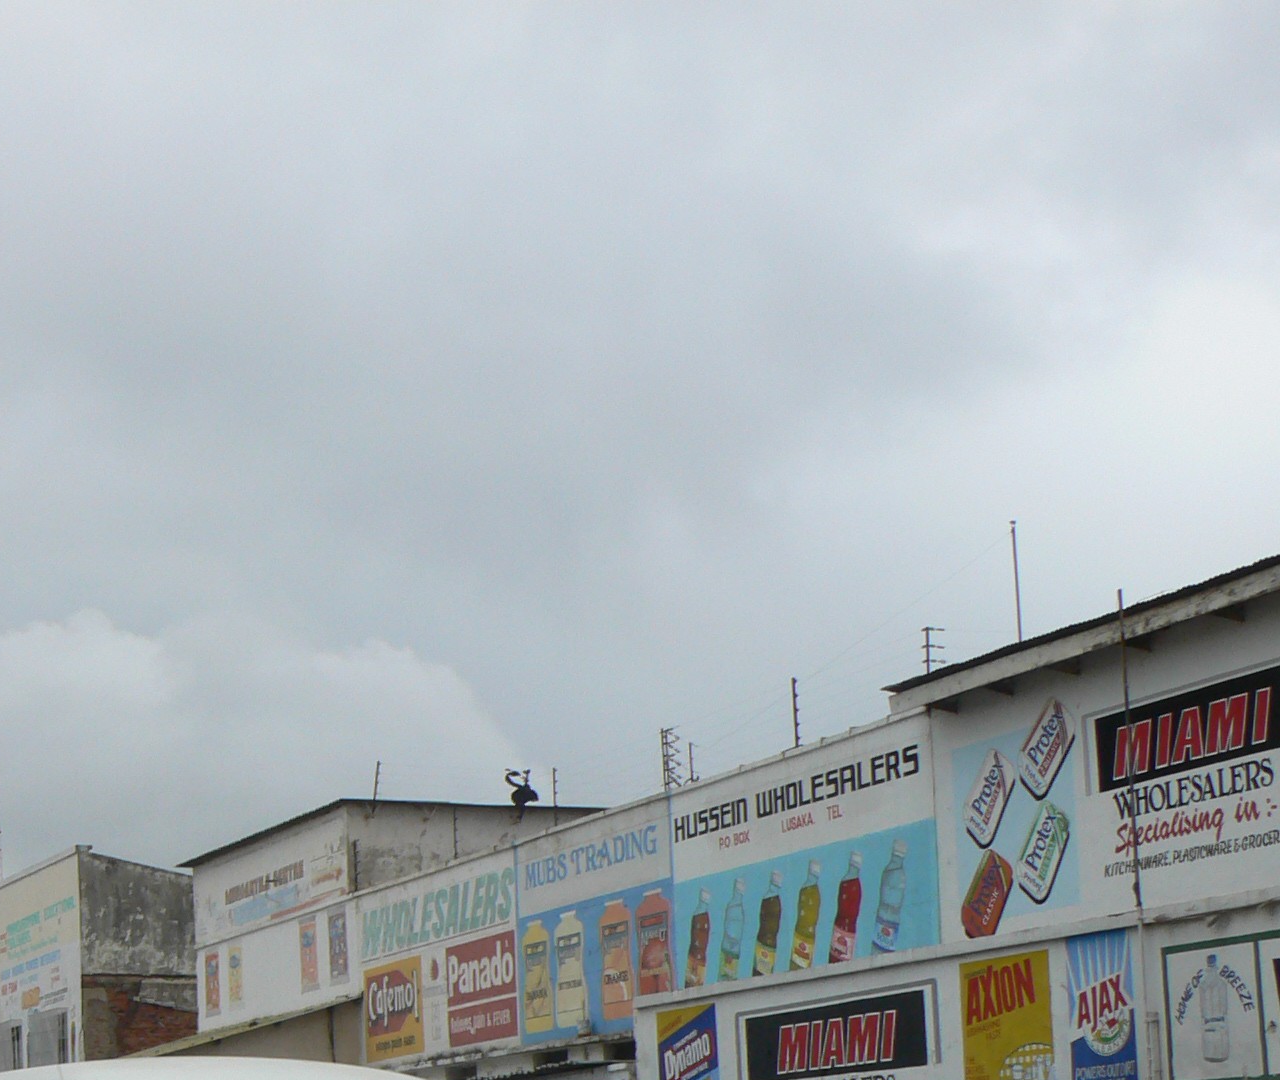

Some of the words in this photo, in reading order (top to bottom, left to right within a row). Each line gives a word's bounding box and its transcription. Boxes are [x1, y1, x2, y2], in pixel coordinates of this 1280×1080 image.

[1026, 710, 1062, 767] Protex
[1113, 687, 1271, 781] MIAMI
[674, 797, 748, 843] HUSSEIN
[755, 744, 919, 818] WHOLESALERS
[971, 763, 1003, 817] Protex
[1112, 758, 1274, 820] WHOLESALERS
[733, 830, 750, 847] BOX
[1025, 814, 1056, 873] Protex
[1115, 807, 1225, 857] Specialising
[1234, 797, 1260, 824] in
[525, 853, 569, 890] MUBS
[571, 825, 657, 875] TRADING
[362, 867, 515, 958] WHOLESALERS
[982, 888, 999, 926] CLASSIC
[368, 968, 419, 1027] Cafemol
[448, 940, 514, 998] Panado
[966, 958, 1036, 1026] AXION
[1174, 987, 1194, 1026] HOME
[1218, 965, 1255, 1012] BREEZE
[1077, 974, 1128, 1033] AJAX
[777, 1009, 896, 1075] MIAMI
[1075, 1065, 1105, 1080] POWERS
